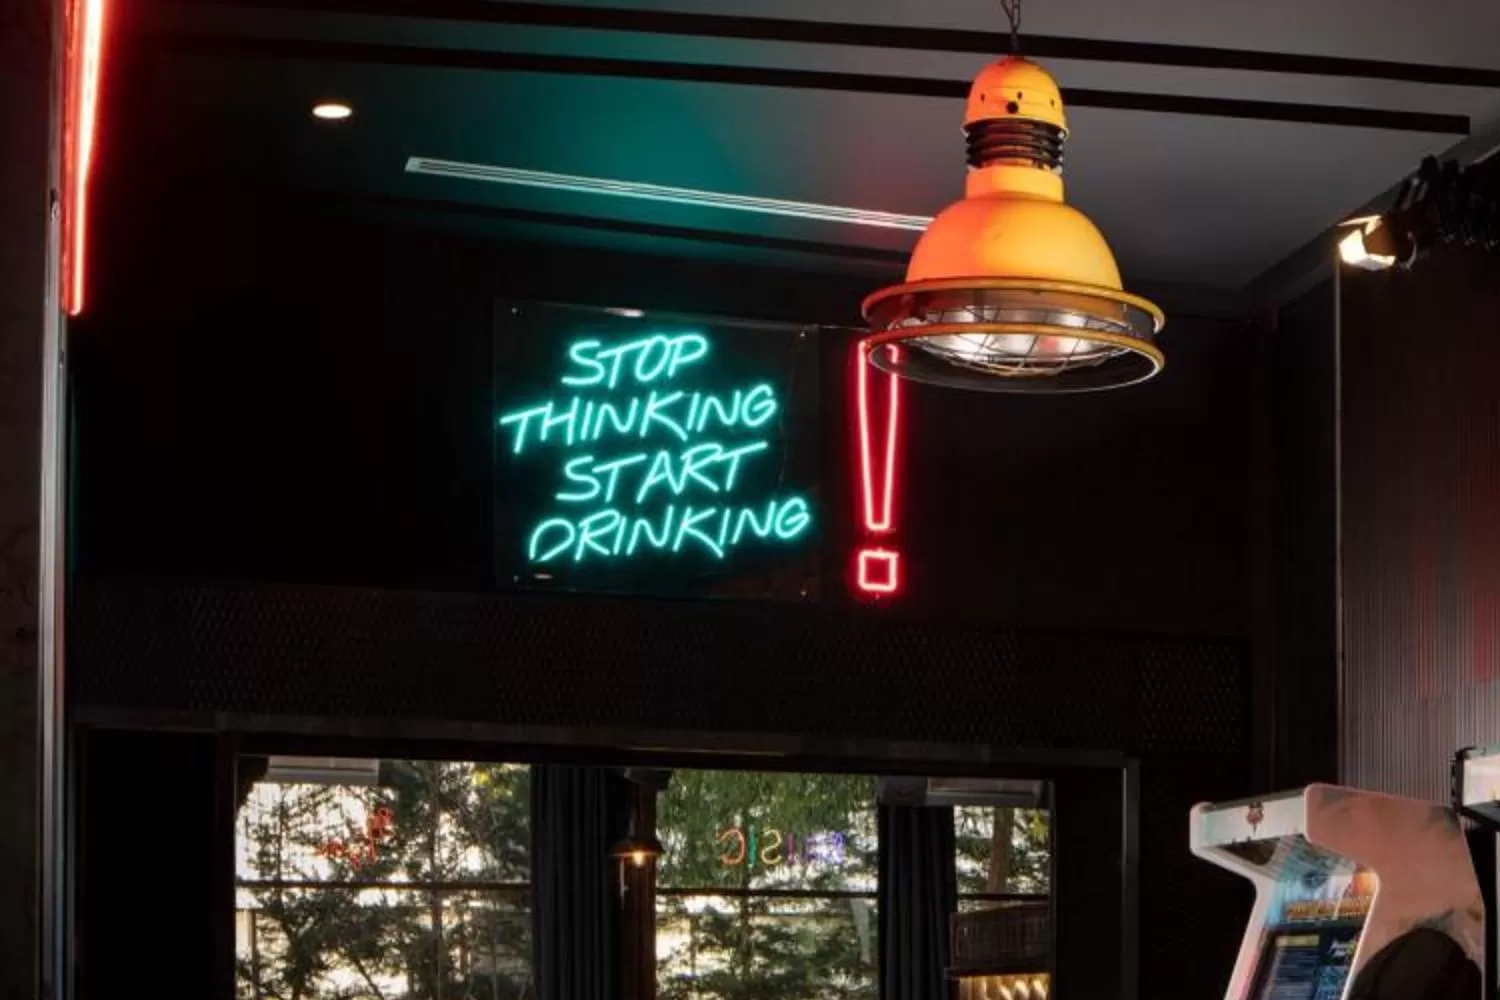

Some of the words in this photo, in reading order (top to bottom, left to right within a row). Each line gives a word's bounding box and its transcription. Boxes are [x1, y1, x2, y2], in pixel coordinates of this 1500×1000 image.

[561, 334, 708, 389] STOP
[499, 383, 778, 454] THINKING
[556, 440, 768, 503] START
[528, 496, 811, 562] DRINKING
